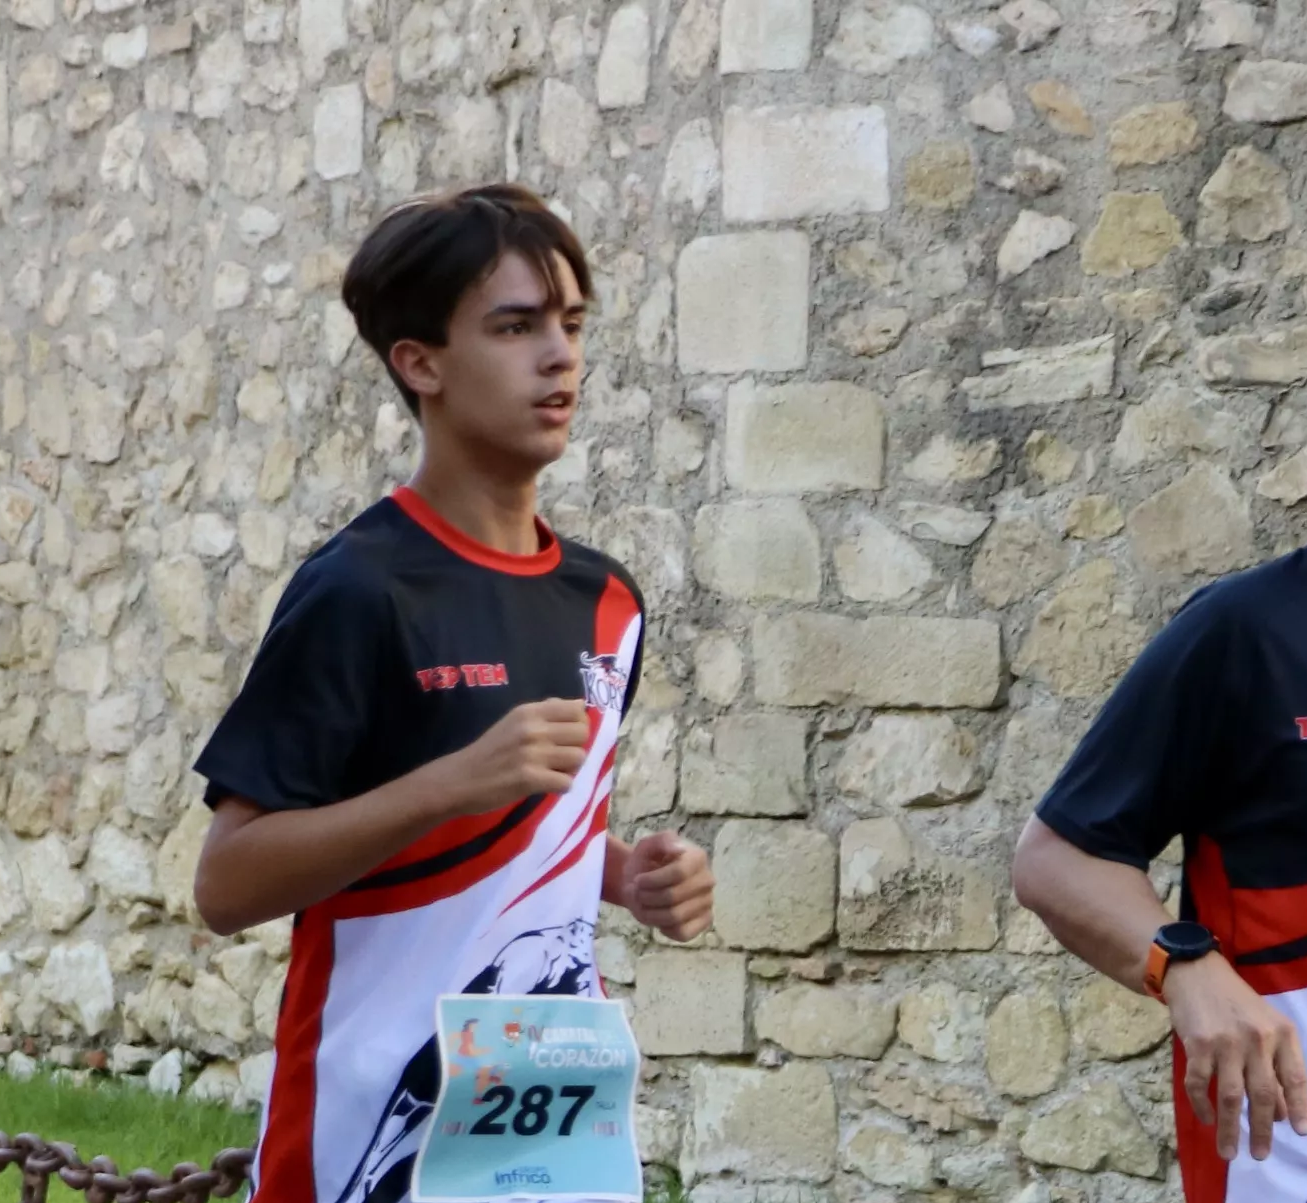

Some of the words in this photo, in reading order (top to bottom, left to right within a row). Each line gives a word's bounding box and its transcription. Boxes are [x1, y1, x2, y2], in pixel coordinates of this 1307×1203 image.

[416, 666, 460, 692] TOP
[460, 663, 509, 687] TEN
[469, 1084, 596, 1136] 287
